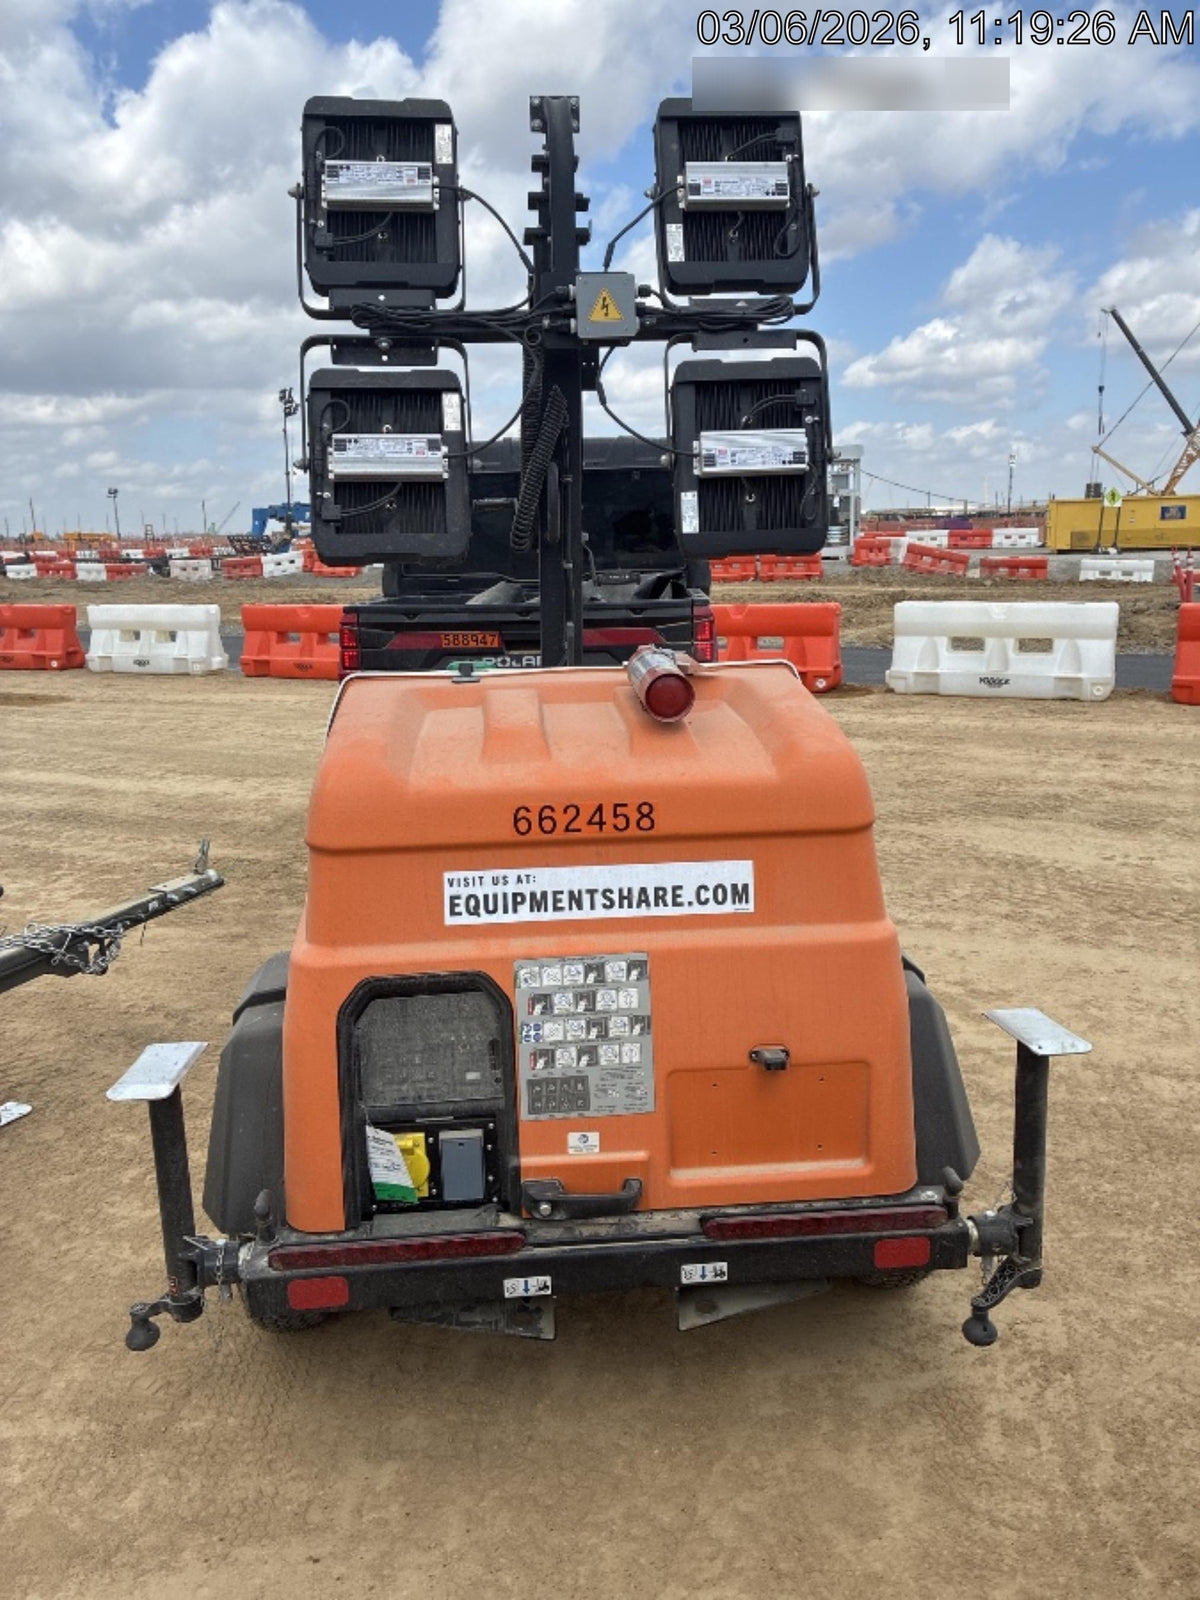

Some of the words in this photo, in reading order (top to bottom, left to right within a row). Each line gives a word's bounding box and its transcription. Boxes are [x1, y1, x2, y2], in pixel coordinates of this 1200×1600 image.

[443, 633, 497, 646] 588947
[513, 801, 655, 836] 662458
[447, 876, 484, 888] VISIT
[491, 875, 509, 886] US
[516, 874, 537, 885] AT:
[448, 883, 750, 918] EQUIPMENTSHARE.COM
